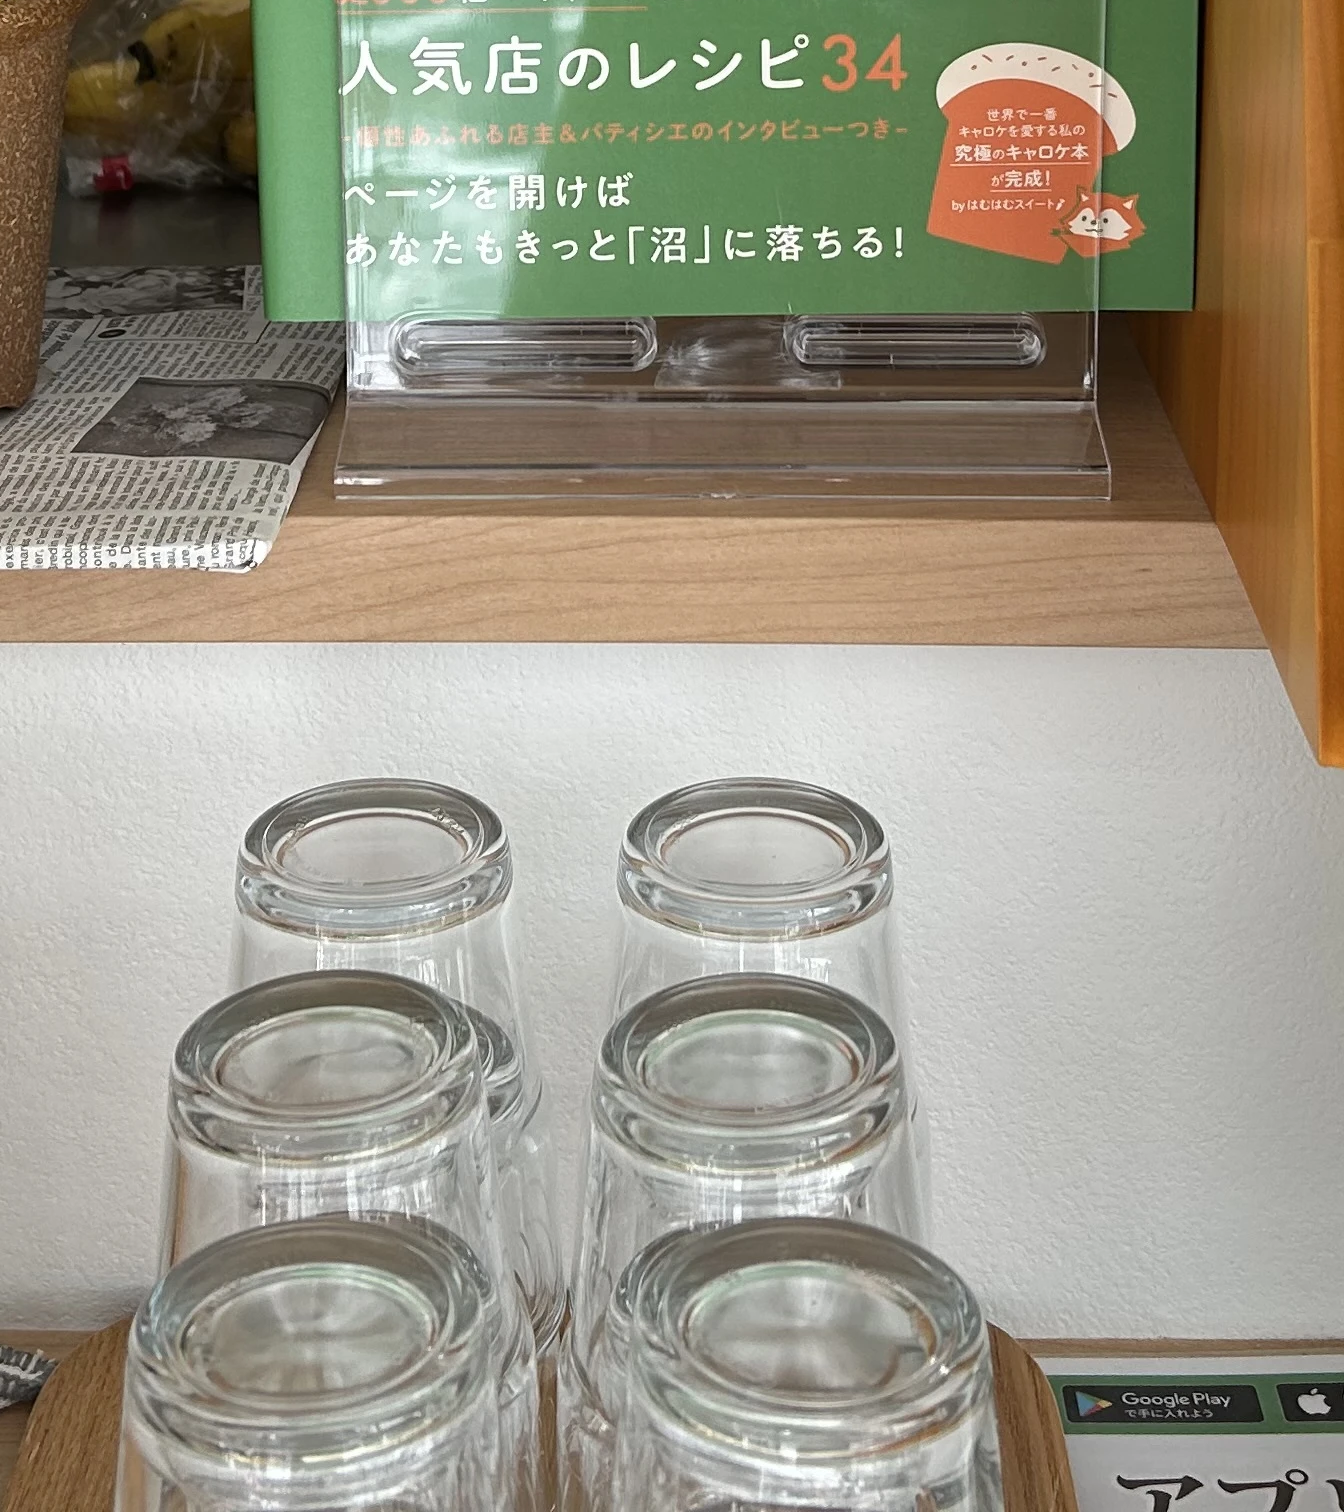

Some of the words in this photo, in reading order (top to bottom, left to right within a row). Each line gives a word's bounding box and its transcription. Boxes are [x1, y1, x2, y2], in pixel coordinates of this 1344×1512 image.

[338, 33, 909, 96] 人気店のレシピ34
[954, 143, 1090, 163] 究極のキャロケ本
[343, 171, 634, 212] ページを開けば
[1121, 1391, 1191, 1409] Google
[1192, 1391, 1232, 1408] Play
[1124, 1408, 1214, 1419] で手に入れよう
